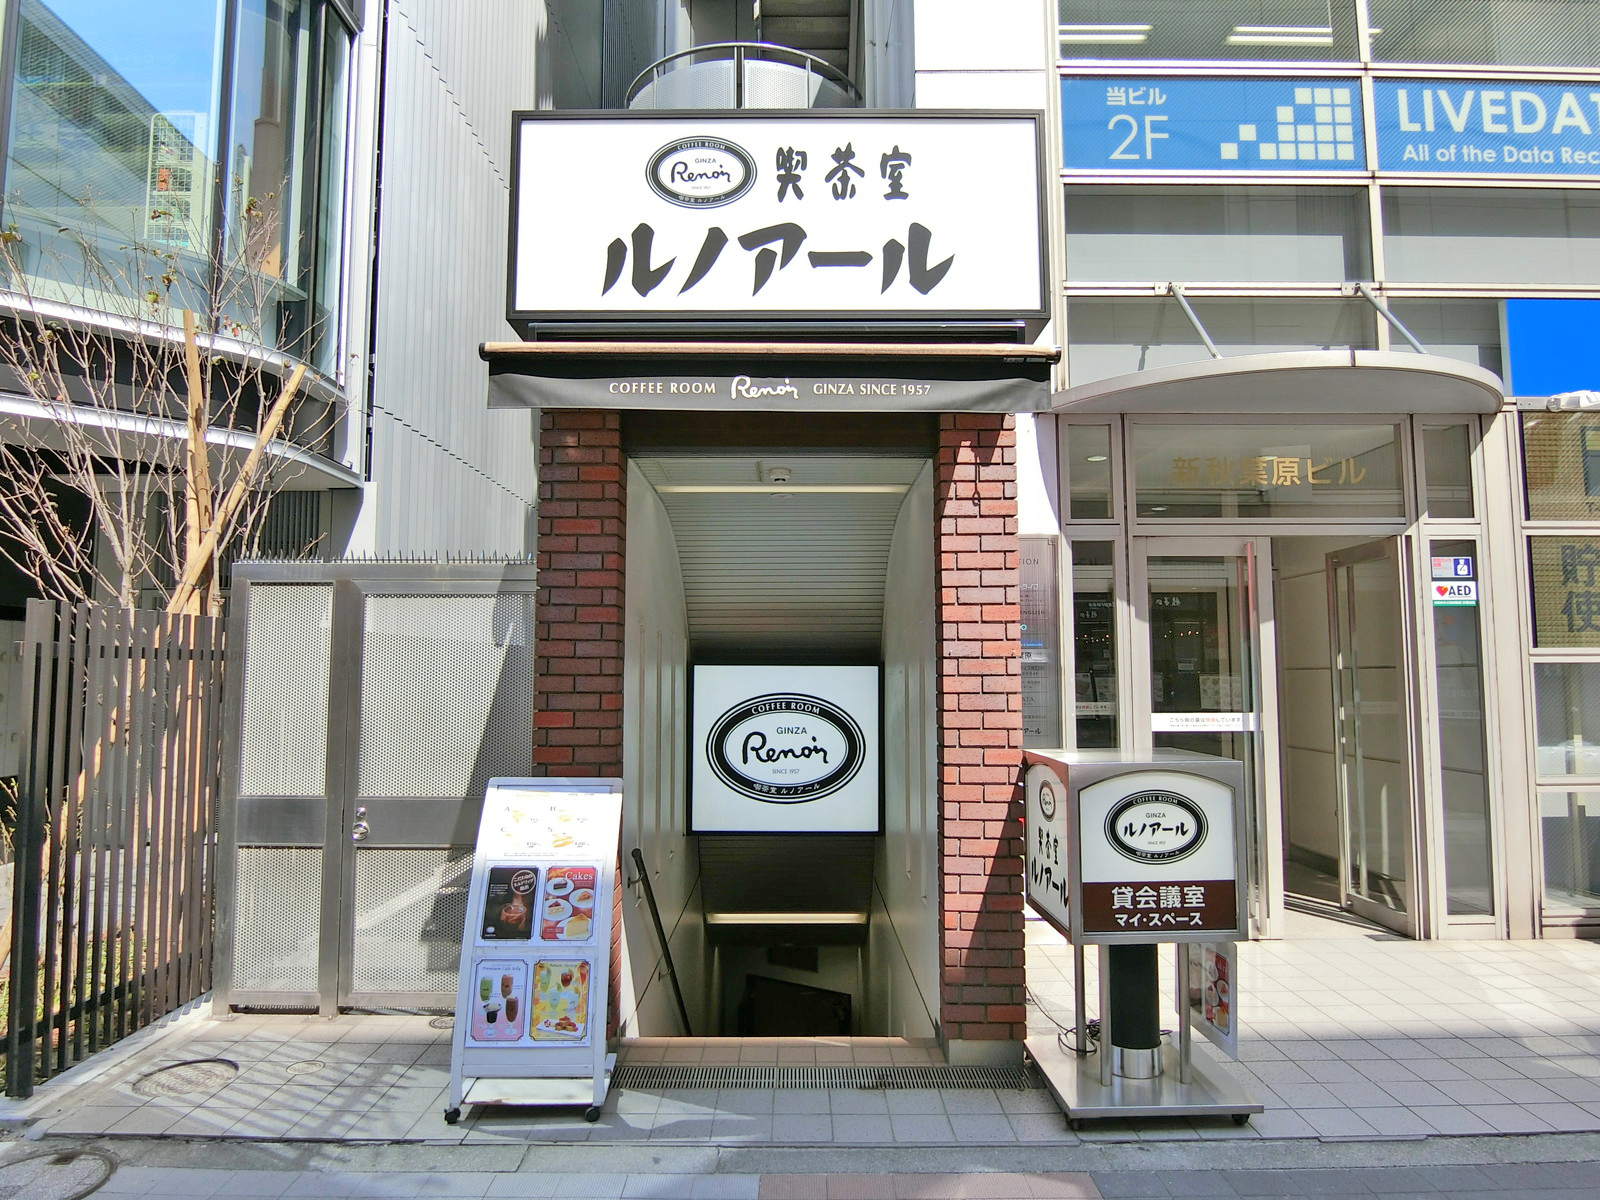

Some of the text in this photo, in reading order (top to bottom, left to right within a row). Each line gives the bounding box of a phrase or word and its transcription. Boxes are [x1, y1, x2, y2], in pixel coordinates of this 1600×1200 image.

[1105, 86, 1167, 106] 当ビル
[677, 141, 726, 150] COFFEE ROOM
[1107, 114, 1170, 160] 2F
[1402, 144, 1430, 161] All
[1436, 145, 1456, 161] of
[1462, 145, 1497, 162] the
[1503, 146, 1554, 163] Data
[670, 161, 732, 183] Renoir
[775, 142, 912, 202] 喫茶室
[602, 222, 955, 297] ルノアール
[608, 374, 931, 399] COFFEE ROOM Renoir GINZA SINCE 1957
[1448, 585, 1471, 596] AED
[751, 702, 820, 714] COFFEE ROOM
[776, 726, 808, 735] GINZA
[742, 731, 829, 765] Renoir
[1132, 795, 1178, 805] COFFEE ROOM
[1123, 821, 1189, 837] ルノアール
[564, 871, 594, 881] Cakes
[1031, 856, 1069, 909] ルノアール
[1111, 885, 1206, 909] 貸会議室
[1114, 912, 1203, 927] マイ・スペース
